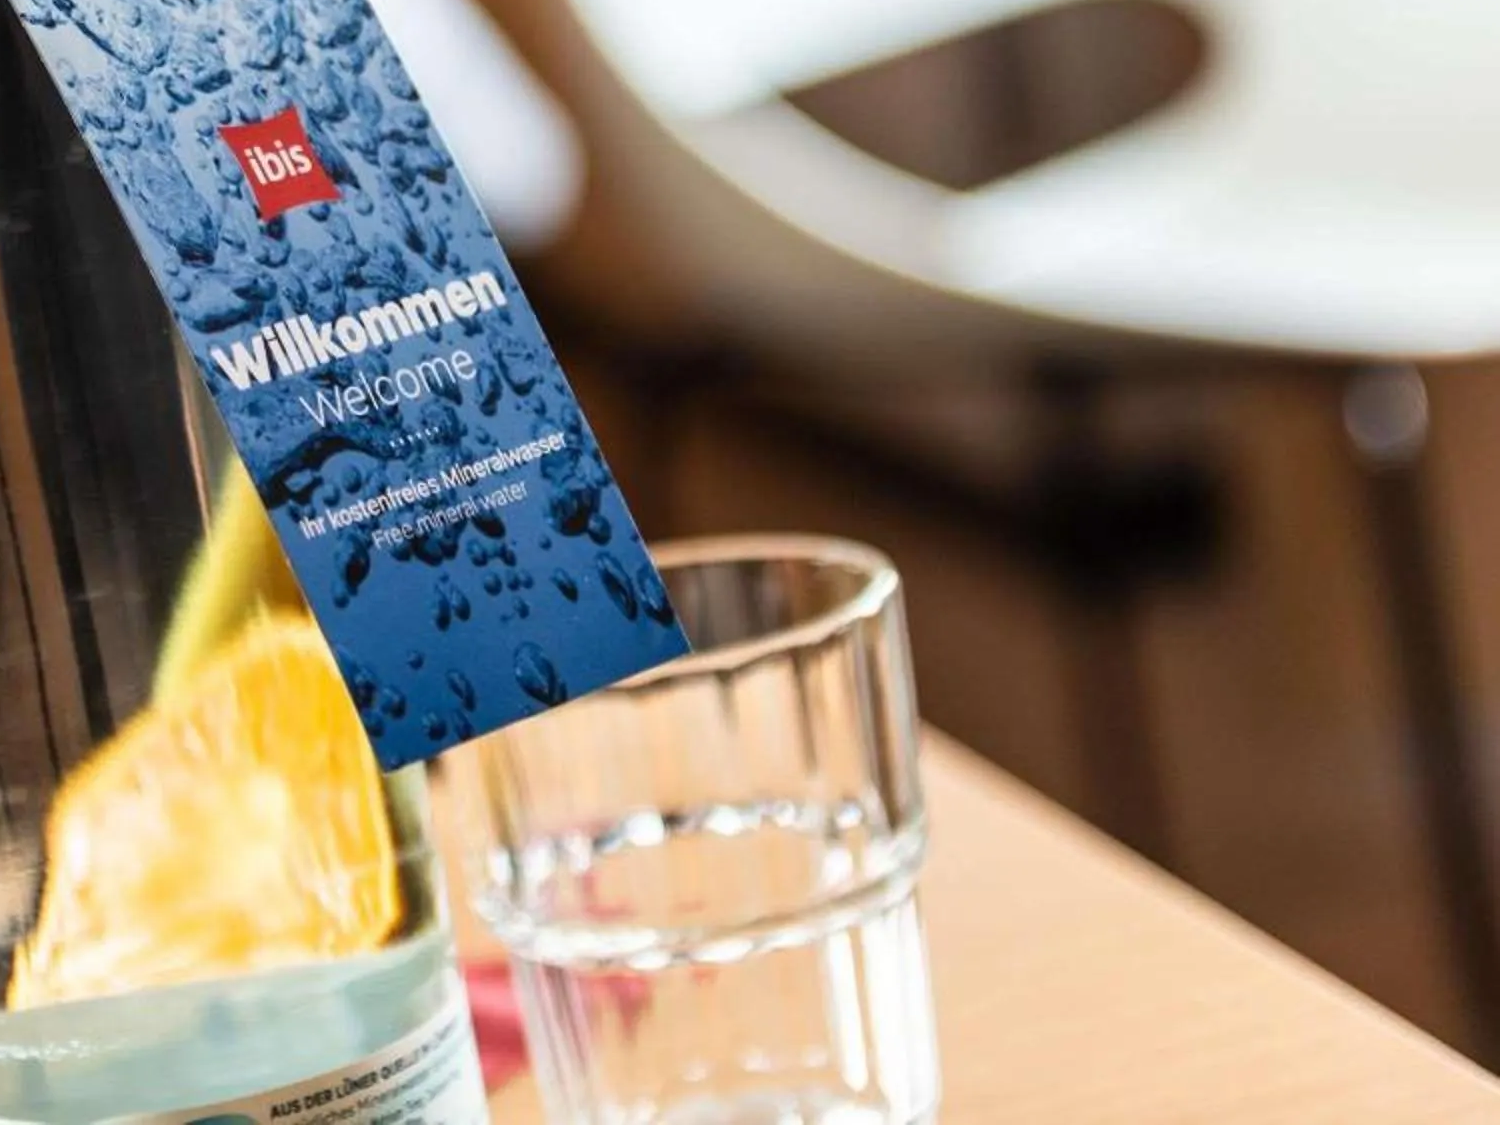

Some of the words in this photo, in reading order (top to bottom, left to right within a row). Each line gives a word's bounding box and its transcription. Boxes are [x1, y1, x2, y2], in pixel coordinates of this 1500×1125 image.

[243, 139, 313, 186] ibis
[210, 271, 508, 391] Willkommen
[299, 348, 478, 428] Welcome
[299, 517, 327, 540] Ihr
[326, 476, 442, 528] kostenfreies
[440, 430, 568, 490] Mineralwasser
[371, 525, 417, 550] Free
[416, 496, 479, 537] mineral
[479, 479, 529, 511] water
[270, 1099, 302, 1119] AUS
[303, 1088, 333, 1110] DER
